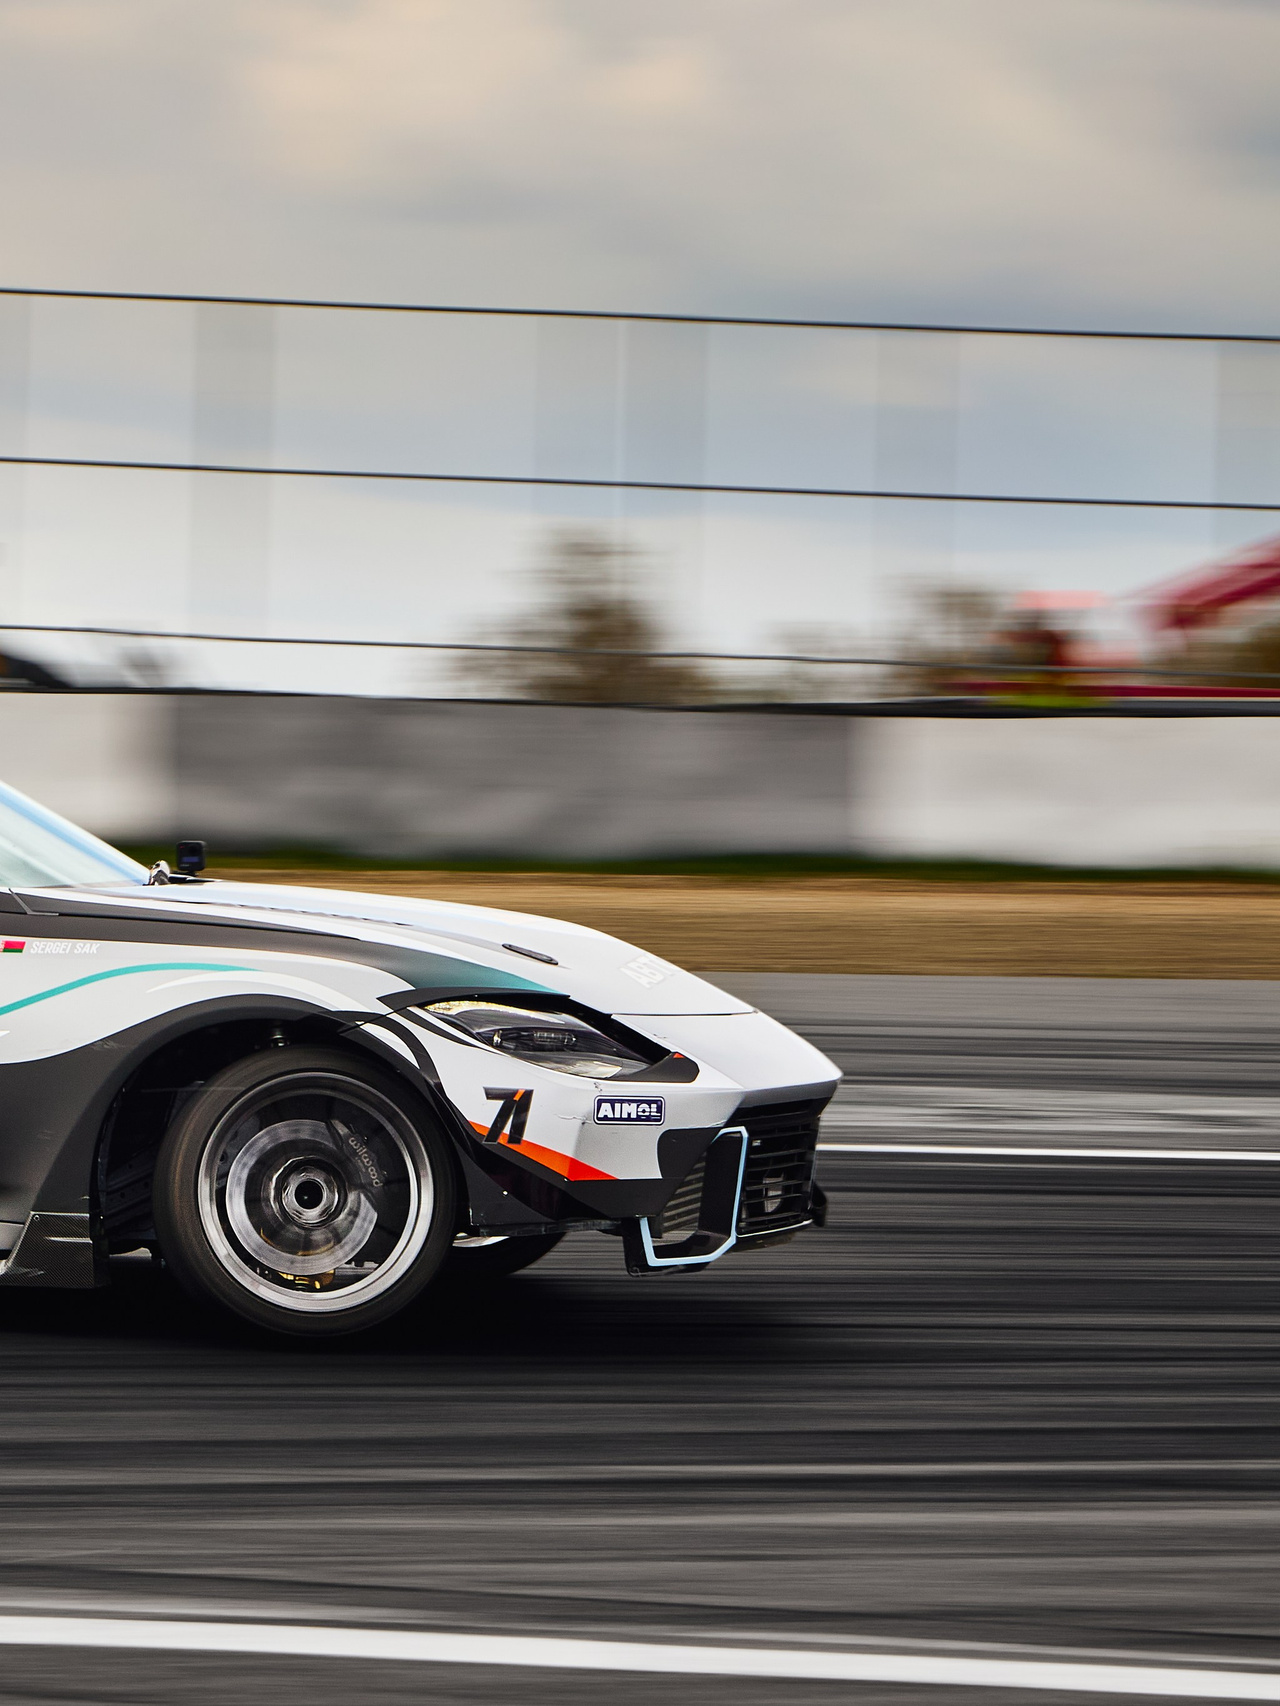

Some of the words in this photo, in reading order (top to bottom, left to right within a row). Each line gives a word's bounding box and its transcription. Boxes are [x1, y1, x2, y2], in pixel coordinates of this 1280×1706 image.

[30, 941, 71, 955] SERGEI
[74, 942, 101, 955] SAK
[618, 955, 673, 988] АВТ
[597, 1102, 661, 1120] AIMOL
[348, 1136, 384, 1188] wilwood
